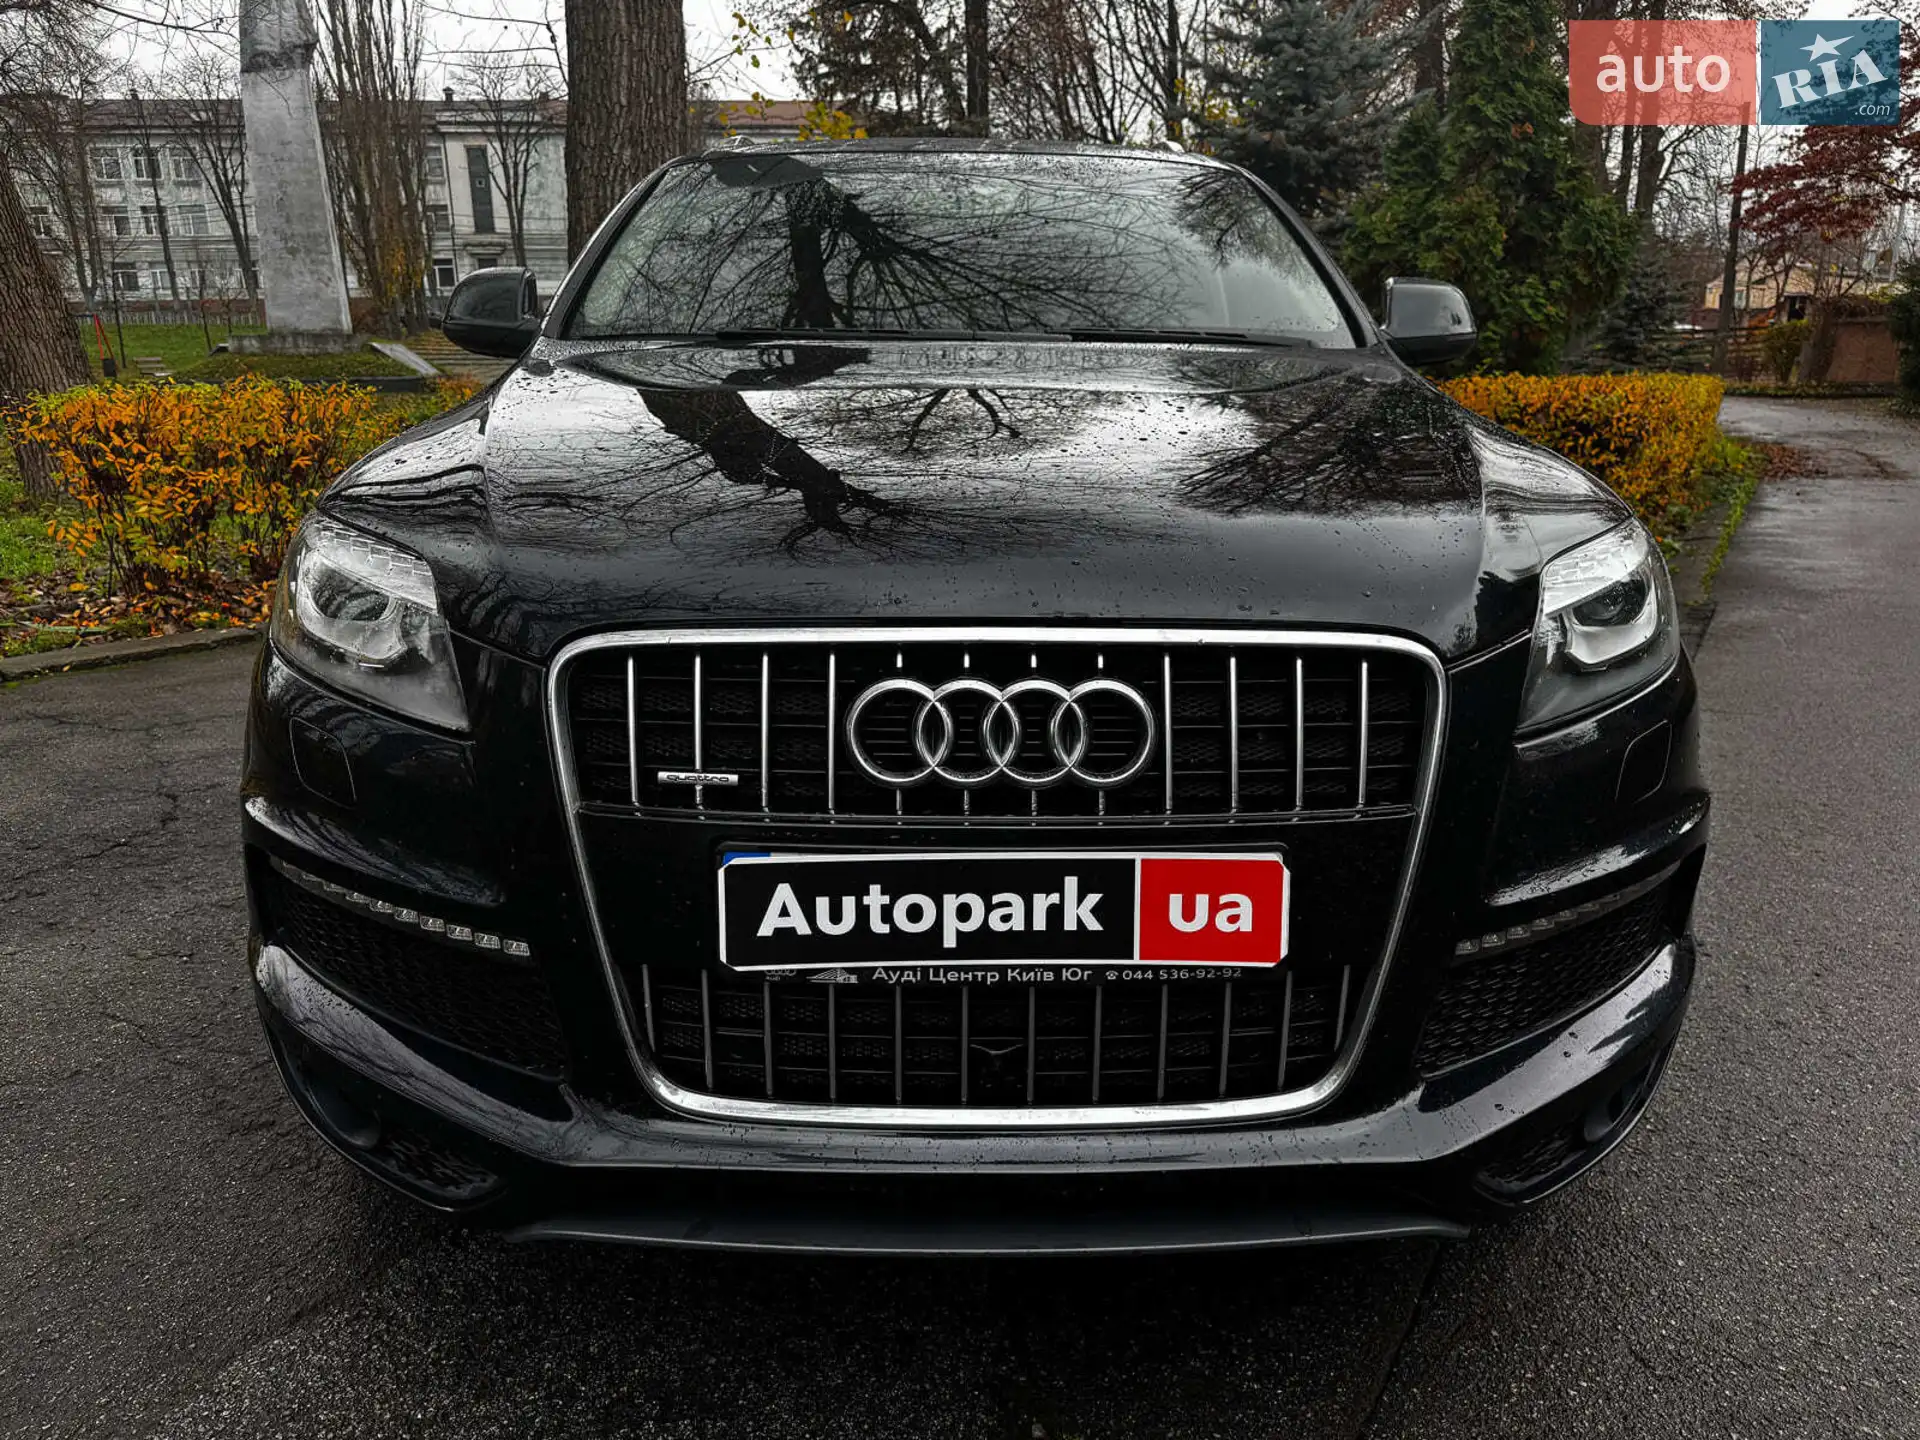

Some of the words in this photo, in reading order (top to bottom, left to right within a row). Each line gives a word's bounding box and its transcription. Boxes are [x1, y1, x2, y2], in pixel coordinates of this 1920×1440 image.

[667, 774, 729, 782] quattro
[756, 876, 1104, 949] Autopark
[1168, 893, 1254, 933] ua
[872, 967, 922, 984] Ауді
[929, 967, 1000, 985] Центр
[1007, 968, 1055, 982] Київ
[1062, 967, 1093, 982] Юг
[1122, 969, 1153, 980] 044
[1159, 967, 1242, 980] 536-92-92
